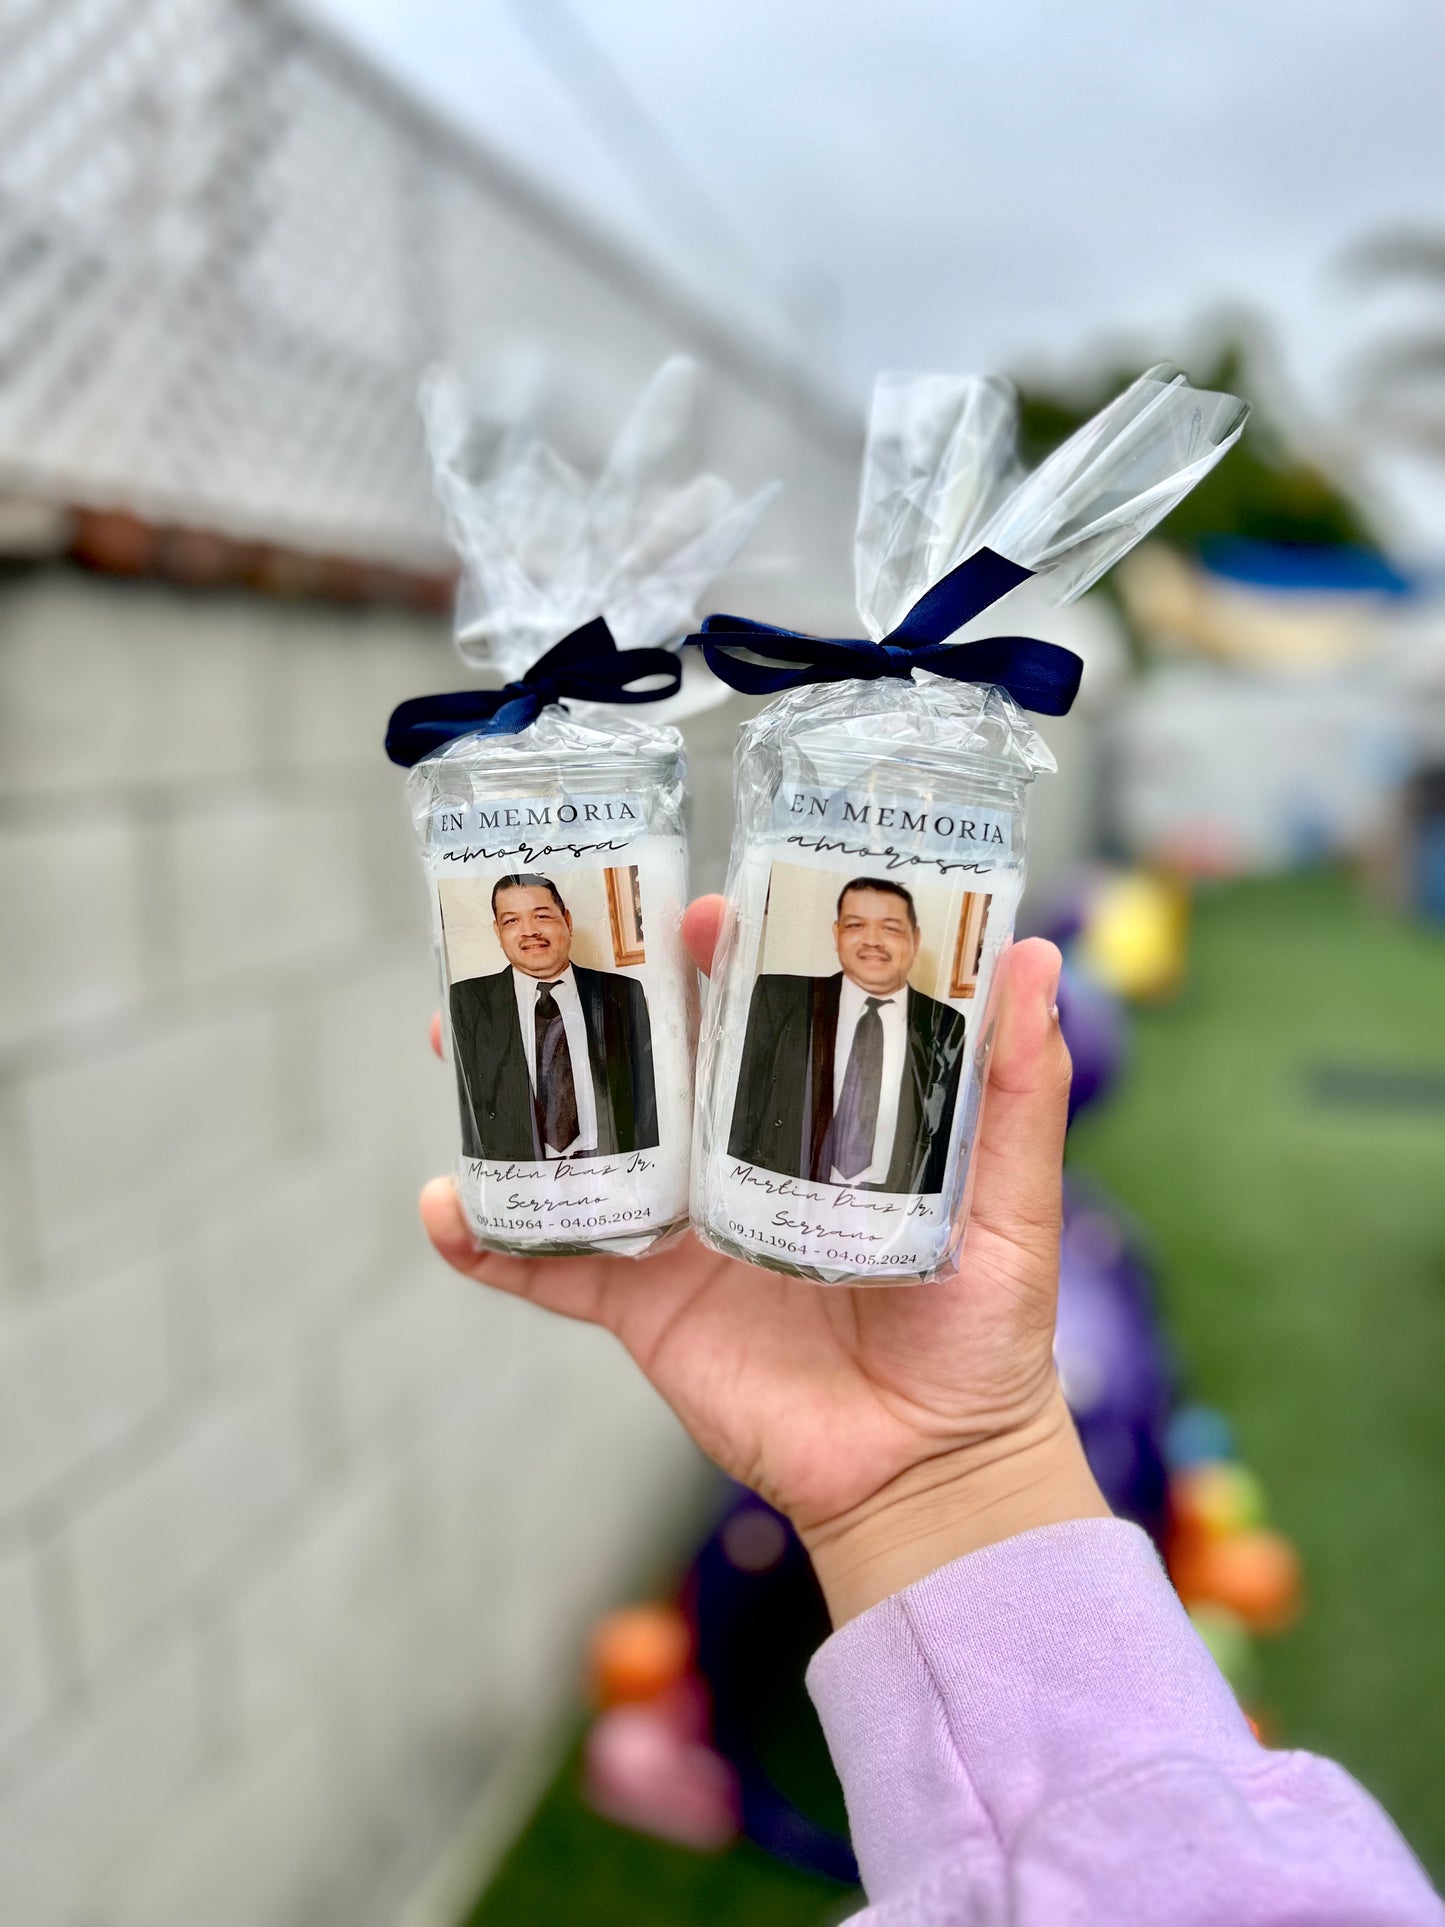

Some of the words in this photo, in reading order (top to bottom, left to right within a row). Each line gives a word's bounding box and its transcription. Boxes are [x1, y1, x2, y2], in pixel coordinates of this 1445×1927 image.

[441, 812, 463, 831] EN
[479, 802, 637, 829] MEMORIA
[789, 793, 829, 816] EN
[841, 801, 1005, 844] MEMORIA
[442, 840, 629, 864] amorosa
[787, 835, 991, 875] amorosa
[627, 1152, 656, 1173] Jr.
[506, 1193, 609, 1212] Serrano
[560, 1207, 651, 1229] 04.05.2024
[771, 1210, 883, 1241] Serrano
[729, 1220, 807, 1255] 09.11.1964
[826, 1248, 917, 1265] 04.05.2024
